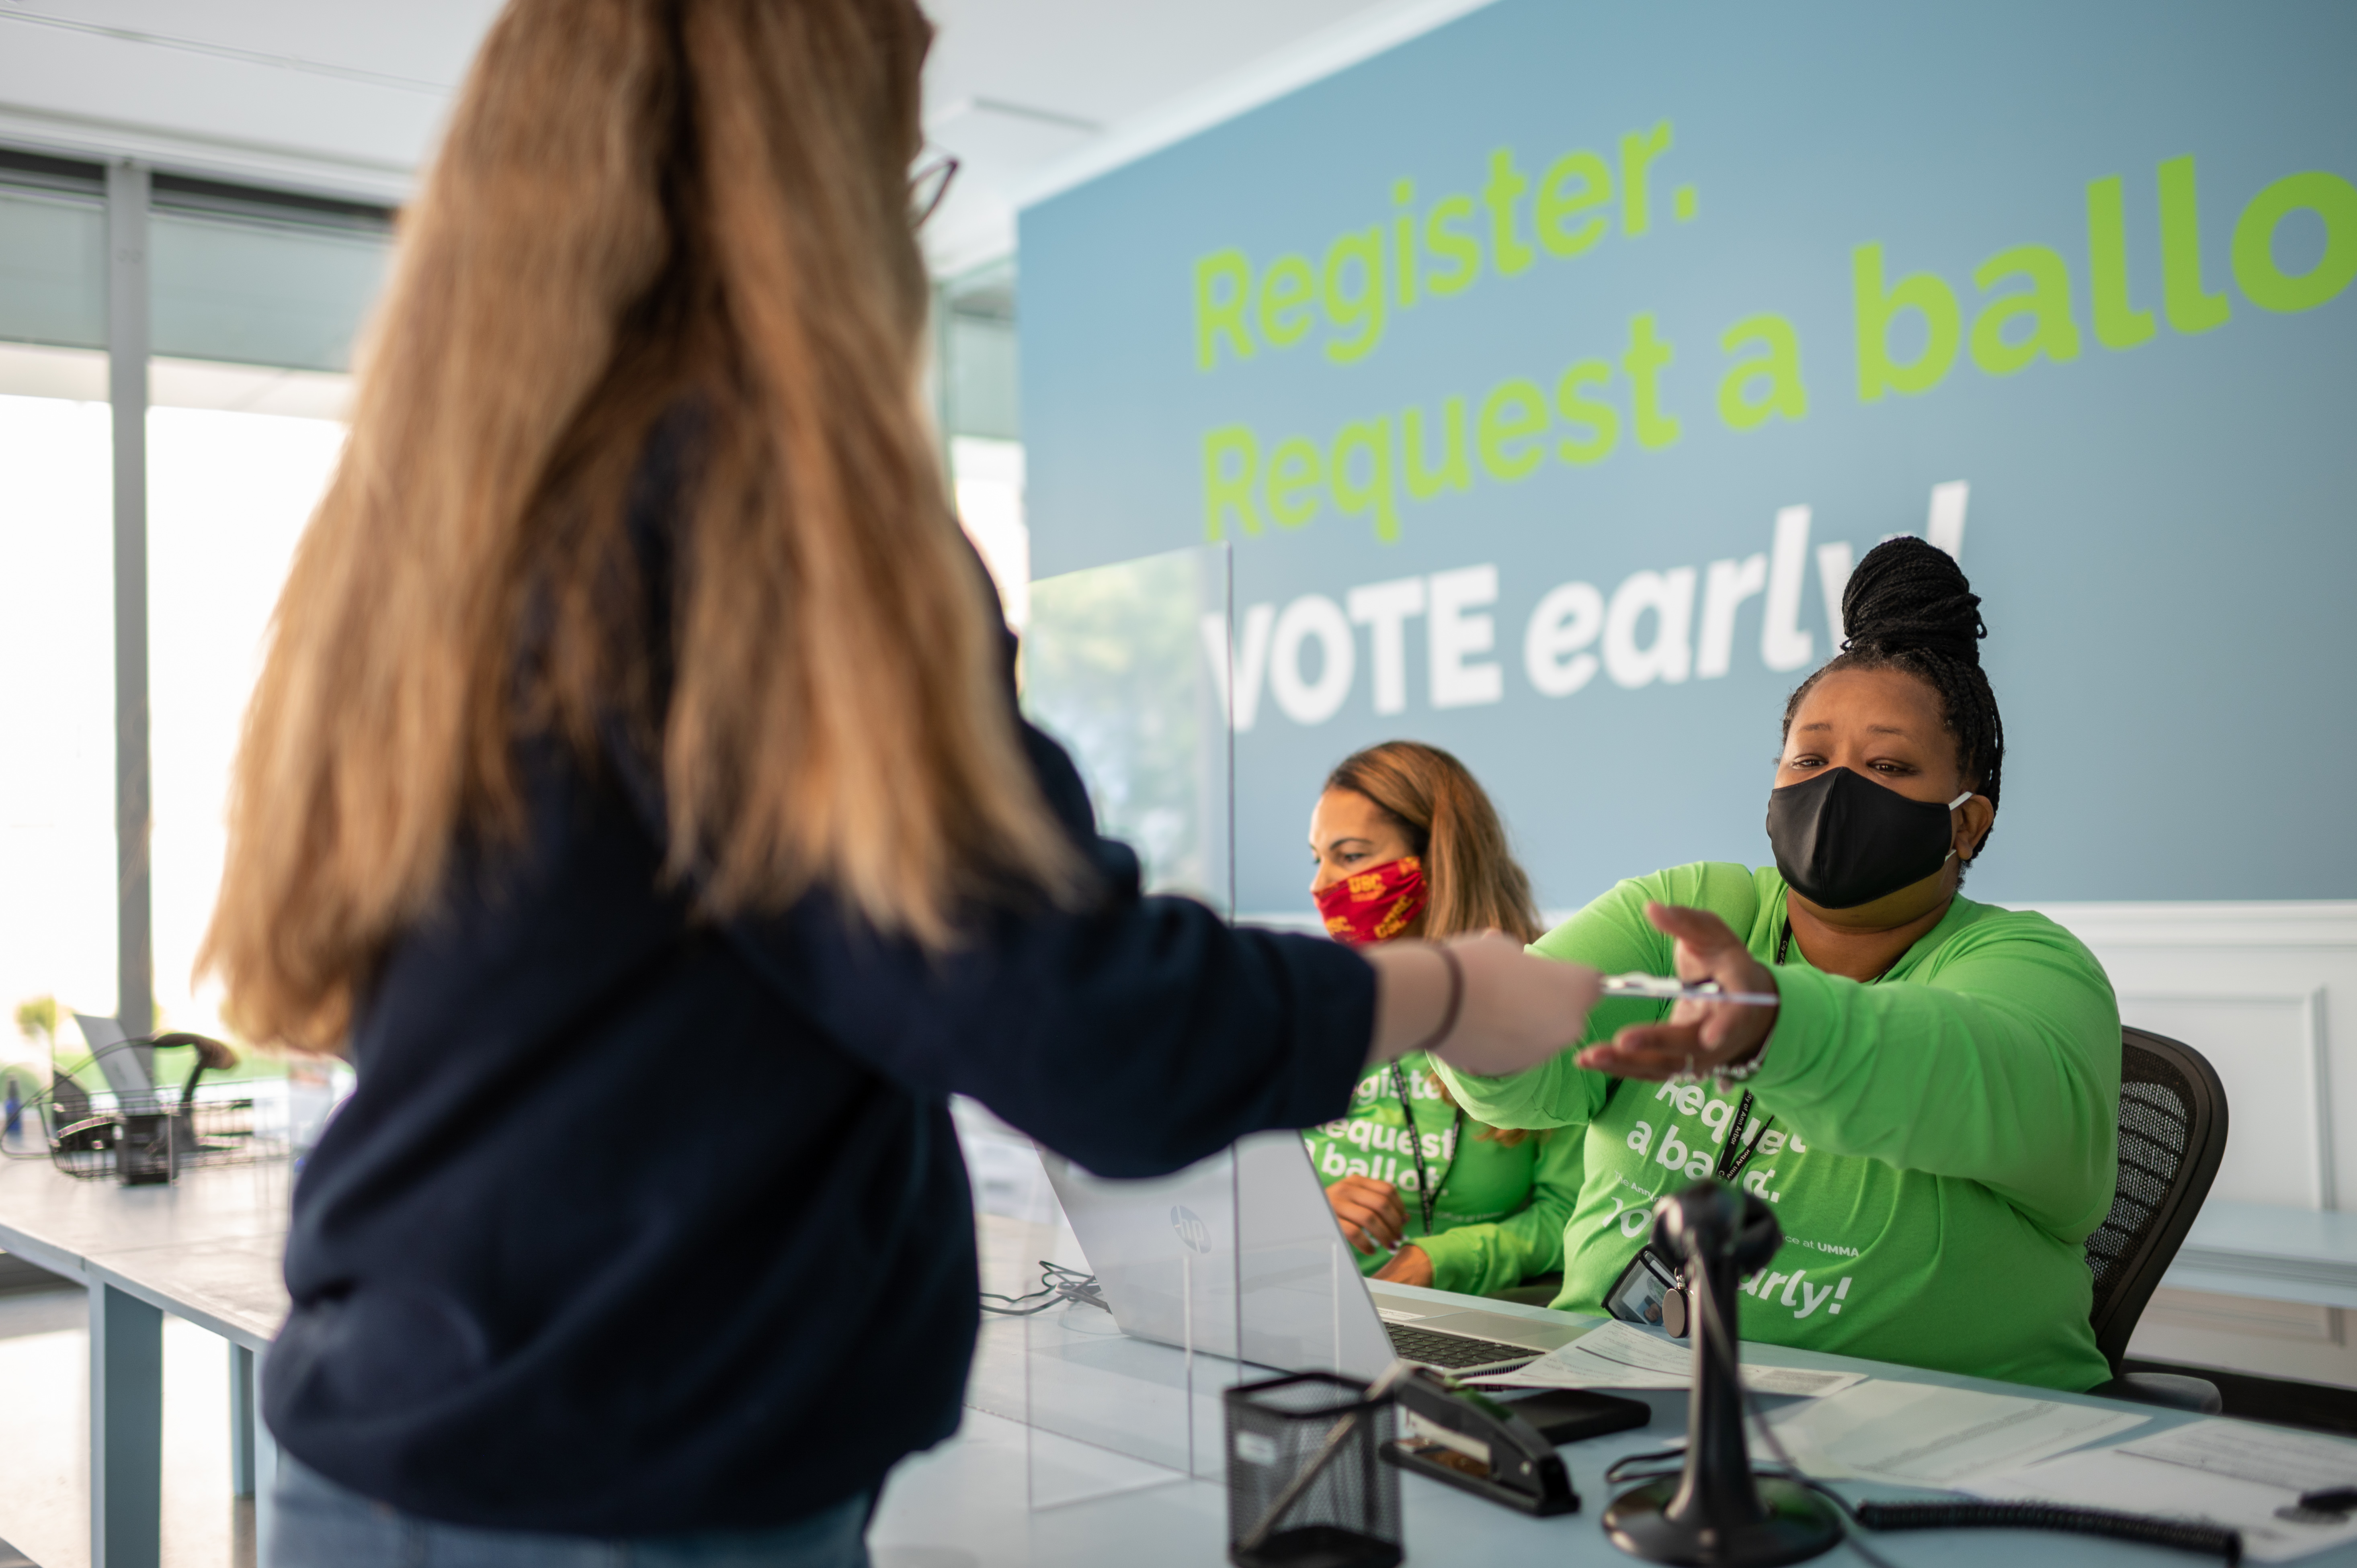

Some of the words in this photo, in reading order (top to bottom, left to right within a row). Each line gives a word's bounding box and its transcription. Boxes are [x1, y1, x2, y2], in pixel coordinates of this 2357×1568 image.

[1192, 119, 1699, 372] Register.
[1202, 312, 1681, 545] Request
[1715, 312, 1807, 432] a
[1200, 563, 1504, 733] VOTE
[1730, 1125, 1742, 1145] Arbor
[1738, 1111, 1746, 1125] Ann
[1315, 1119, 1454, 1161] equest
[1627, 1120, 1652, 1156] a
[1614, 1170, 1629, 1186] The
[1726, 1166, 1738, 1179] Ann
[1736, 1148, 1750, 1167] Arbor
[1803, 1240, 1815, 1249] at
[1817, 1242, 1859, 1257] UMMA
[1738, 1267, 1853, 1319] arly!
